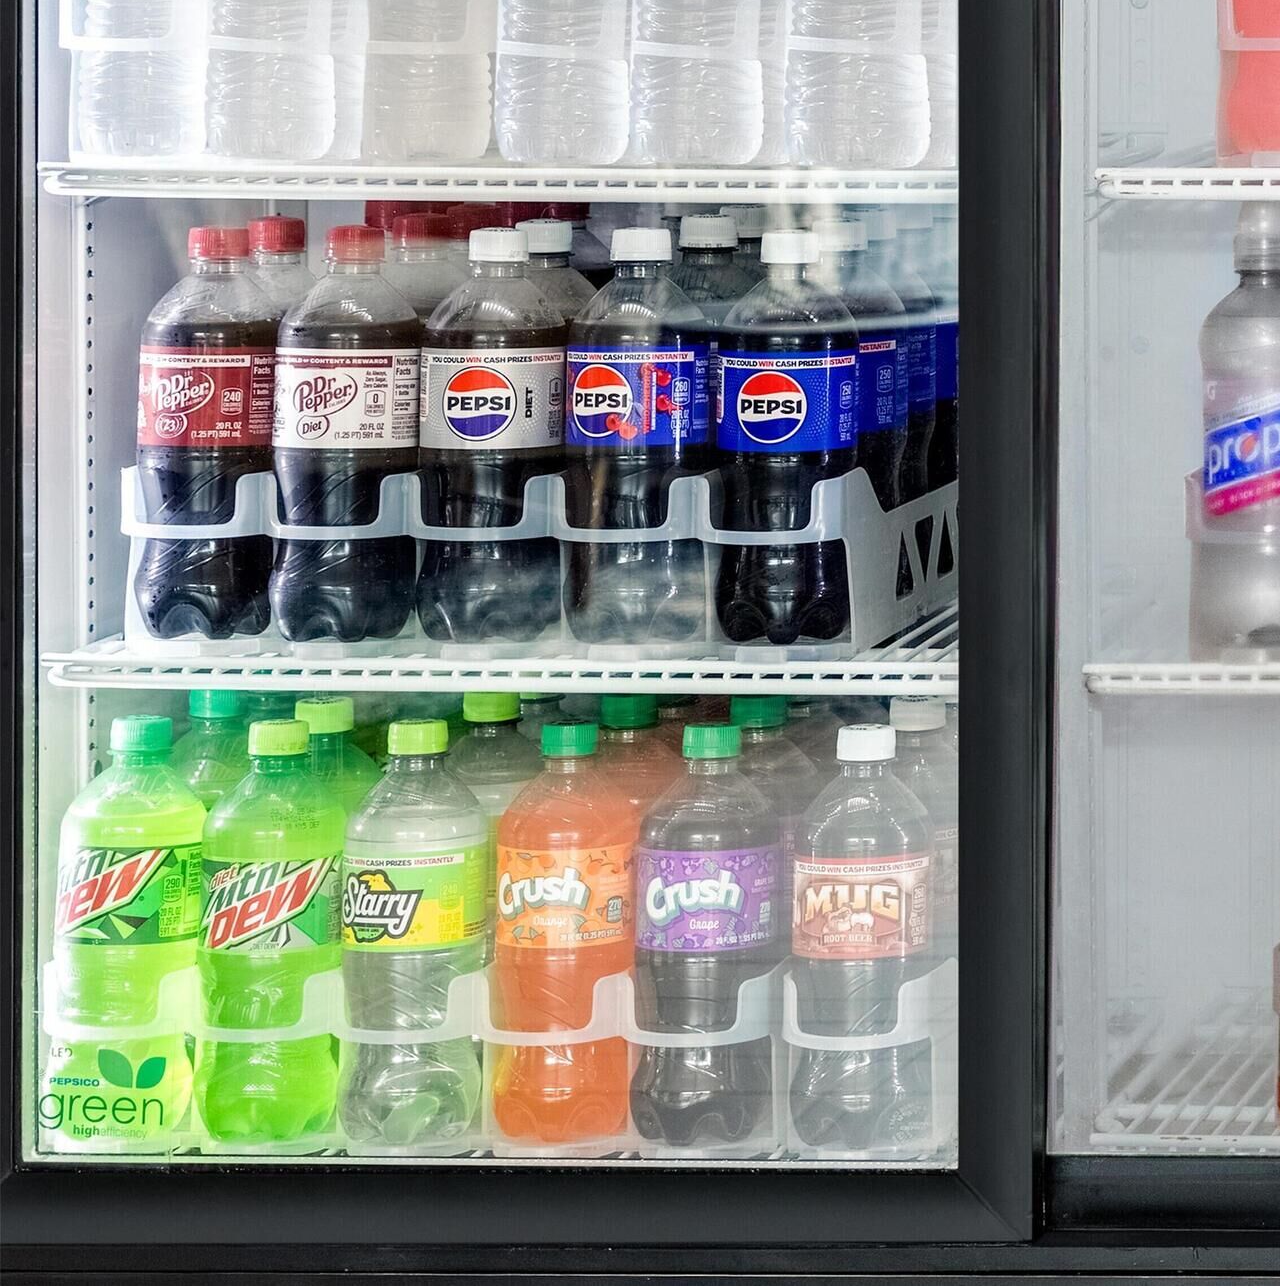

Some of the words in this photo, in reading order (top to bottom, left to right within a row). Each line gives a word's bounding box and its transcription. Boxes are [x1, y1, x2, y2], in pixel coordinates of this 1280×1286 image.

[443, 356, 466, 364] COULD
[484, 356, 506, 364] CASH
[507, 355, 533, 363] PRIZES
[652, 352, 689, 360] INSTANTLY
[798, 359, 823, 367] PRIZES
[880, 368, 891, 379] 250
[171, 374, 195, 395] Dr
[313, 375, 336, 395] Dr
[674, 381, 688, 392] 260
[223, 391, 241, 402] 240
[298, 381, 353, 414] Pepper
[447, 395, 511, 411] PEPSI
[525, 387, 533, 418] DIET
[574, 393, 628, 408] PEPSI
[740, 398, 801, 414] PEPSI
[302, 420, 322, 434] Diet
[366, 859, 385, 867] CASH
[385, 859, 412, 867] PRIZES
[414, 856, 455, 865] INSTANTLY
[866, 864, 892, 873] PRIZES
[165, 878, 181, 889] 290
[210, 865, 237, 889] diet
[499, 866, 588, 919] Crush
[646, 869, 743, 925] Crush
[344, 876, 419, 937] Starry
[804, 884, 900, 923] MUG
[532, 915, 568, 927] Orange
[689, 919, 720, 931] Grape
[823, 934, 846, 943] ROOT
[849, 934, 873, 943] BEER
[49, 1076, 100, 1087] PEPSICO
[39, 1094, 164, 1129] green
